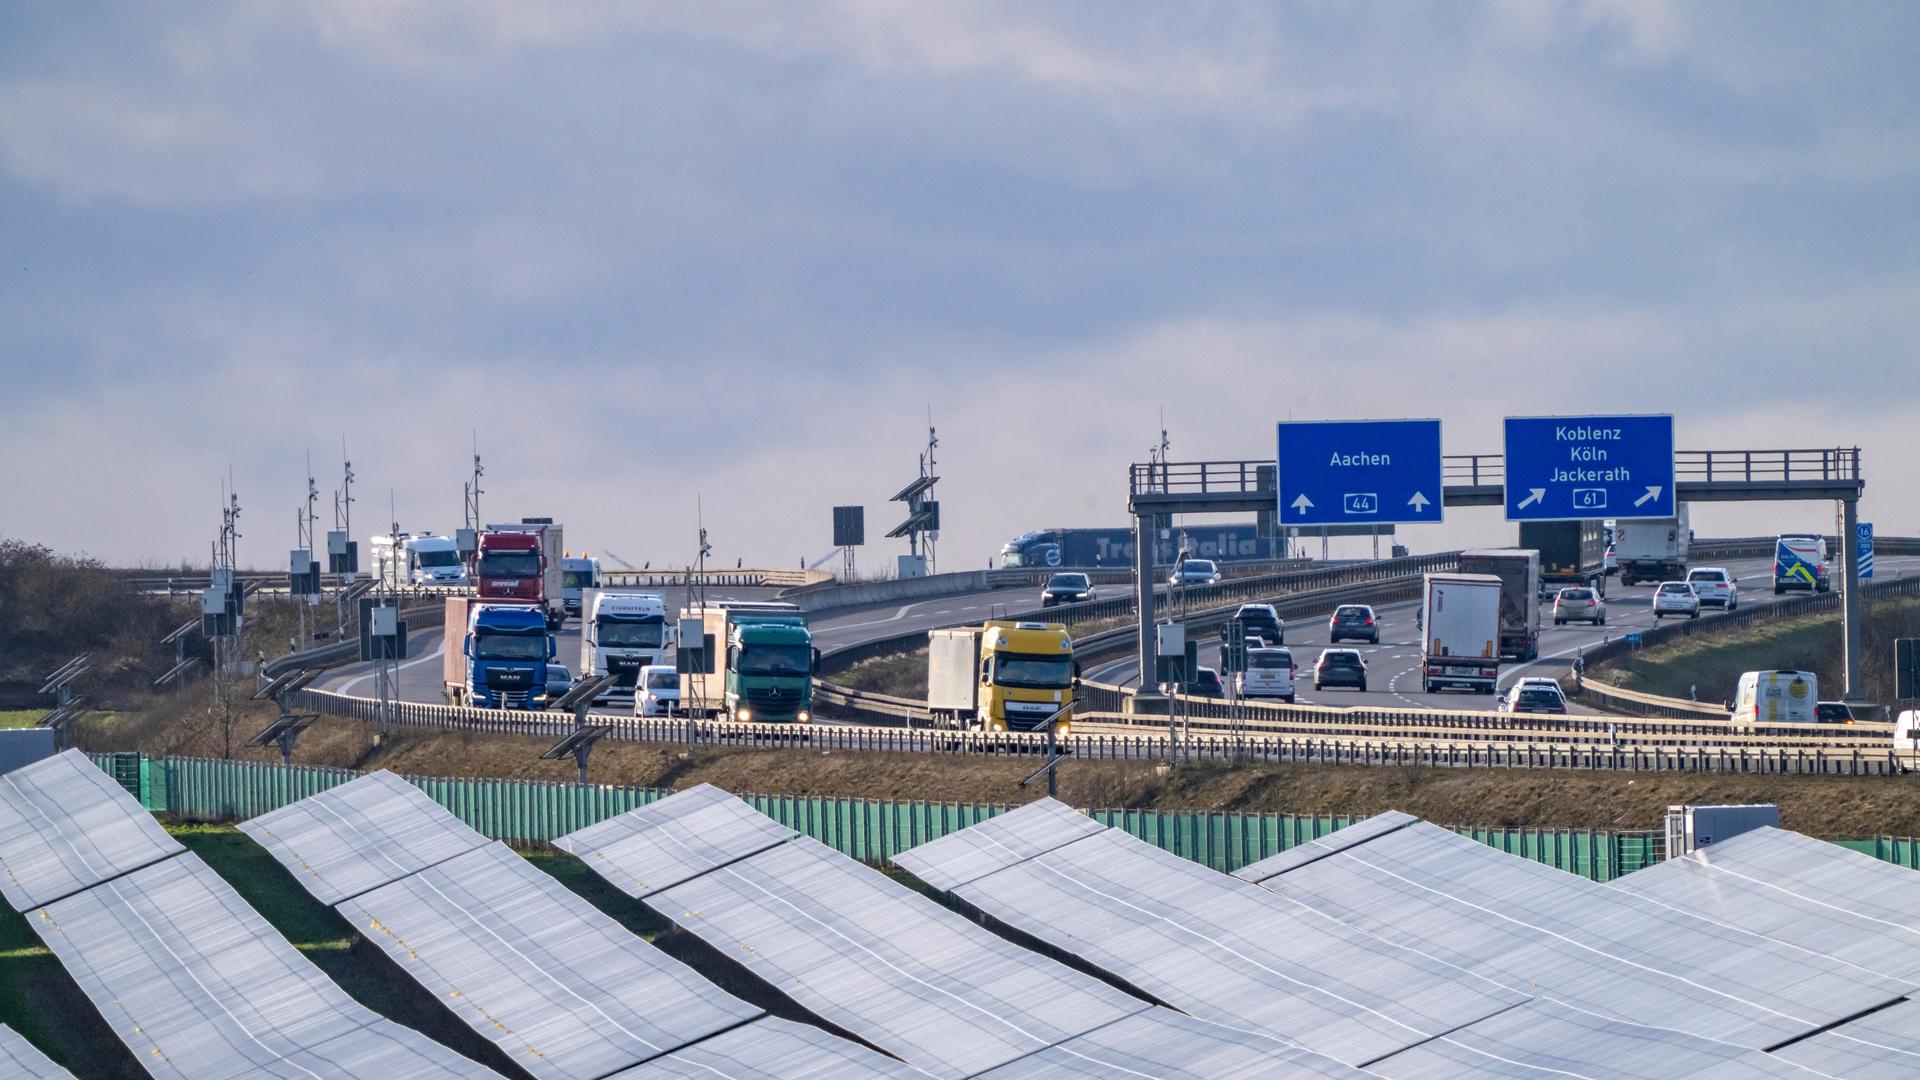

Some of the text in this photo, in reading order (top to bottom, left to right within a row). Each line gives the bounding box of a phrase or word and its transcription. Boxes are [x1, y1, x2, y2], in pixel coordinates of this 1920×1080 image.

[1556, 426, 1622, 442] Koblenz
[1330, 451, 1391, 467] Aachen
[1571, 446, 1608, 462] Köln
[1550, 466, 1631, 482] Jackerath
[1352, 497, 1369, 510] 44
[1583, 492, 1597, 505] 61
[1860, 527, 1870, 536] 16
[1096, 537, 1173, 559] Tras
[491, 580, 519, 588] onroad
